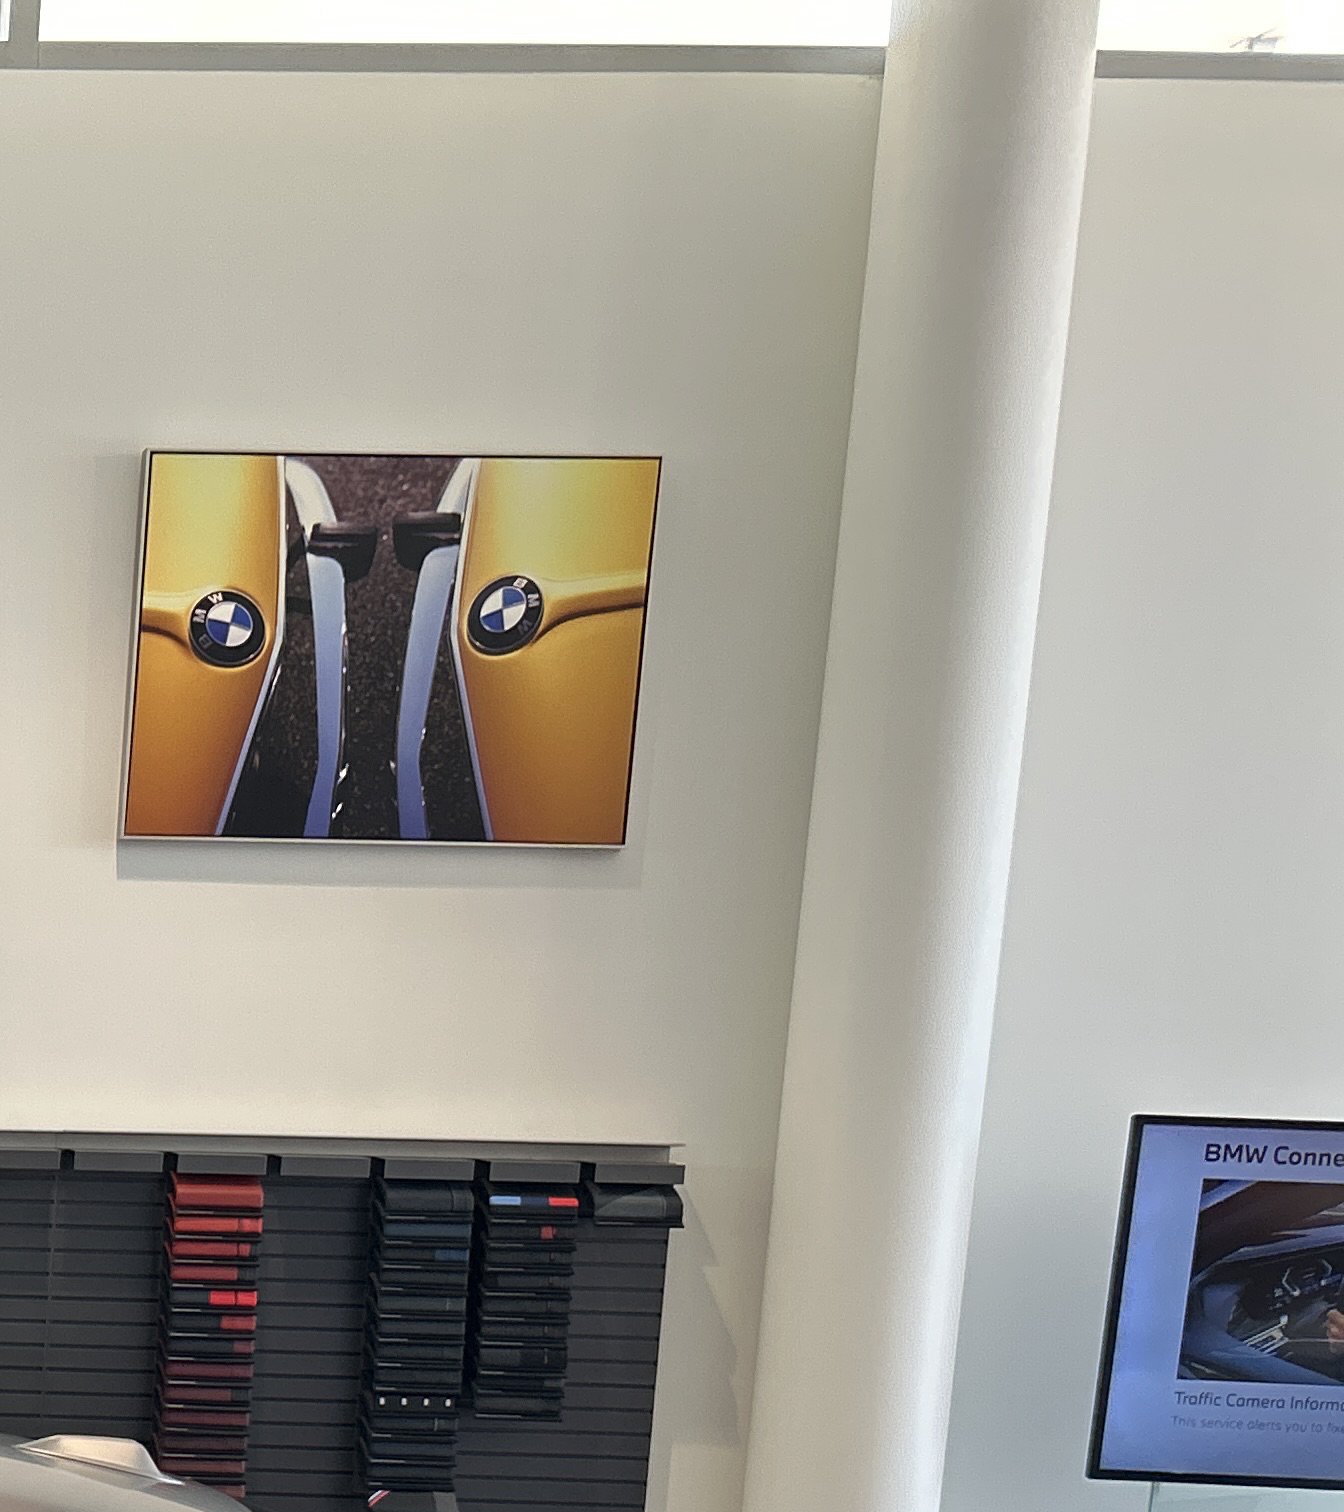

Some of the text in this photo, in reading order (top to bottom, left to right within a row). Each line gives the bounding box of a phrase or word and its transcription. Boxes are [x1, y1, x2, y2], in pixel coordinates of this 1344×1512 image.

[1204, 1143, 1268, 1163] BMW
[1174, 1391, 1222, 1407] Traffic
[1226, 1393, 1285, 1409] Camera
[1200, 1416, 1243, 1430] service
